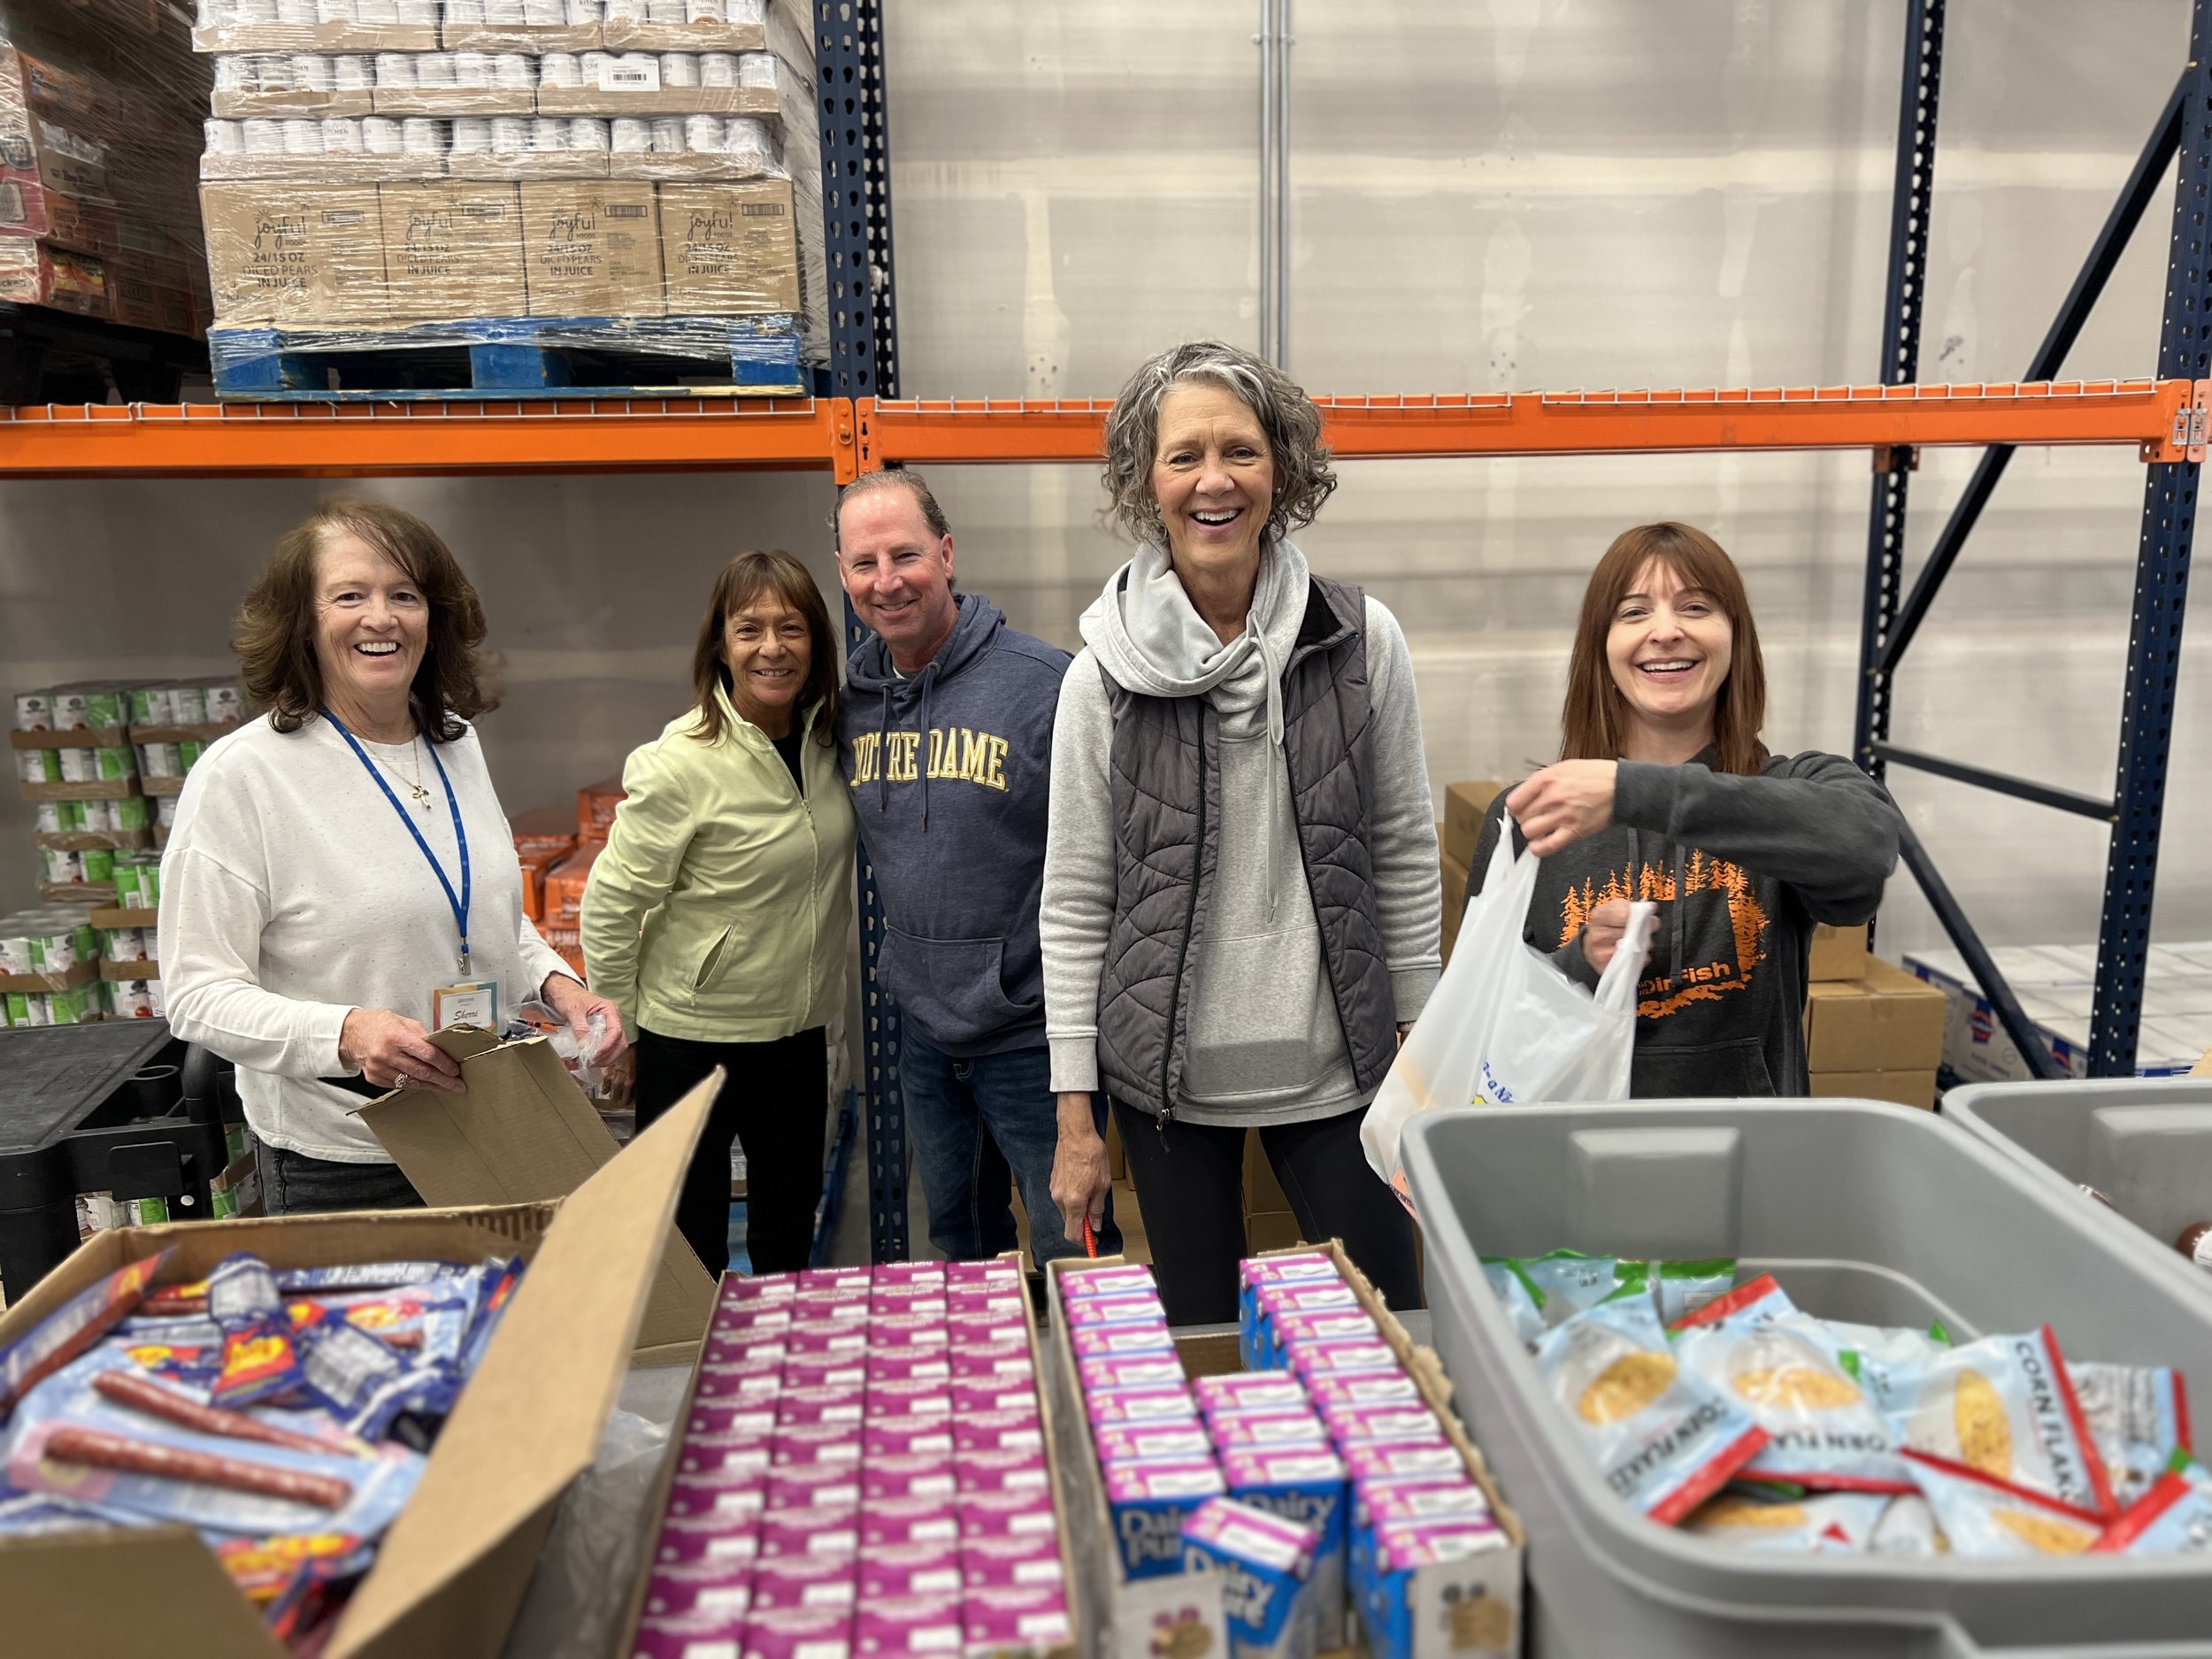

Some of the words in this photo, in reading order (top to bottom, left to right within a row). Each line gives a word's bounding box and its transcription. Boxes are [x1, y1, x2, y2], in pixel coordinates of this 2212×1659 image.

[254, 216, 307, 250] joyful
[549, 212, 595, 242] joyful
[253, 252, 287, 263] 24/15
[288, 253, 306, 263] OZ
[242, 265, 280, 276] DICED
[281, 265, 319, 276] PEARS
[407, 265, 419, 274] IN
[550, 266, 561, 276] IN
[565, 266, 594, 276] JUICE
[849, 730, 921, 787] NOTRE
[926, 726, 1010, 792] DAME
[453, 1009, 479, 1021] Sherri
[2015, 1340, 2055, 1413] CORN
